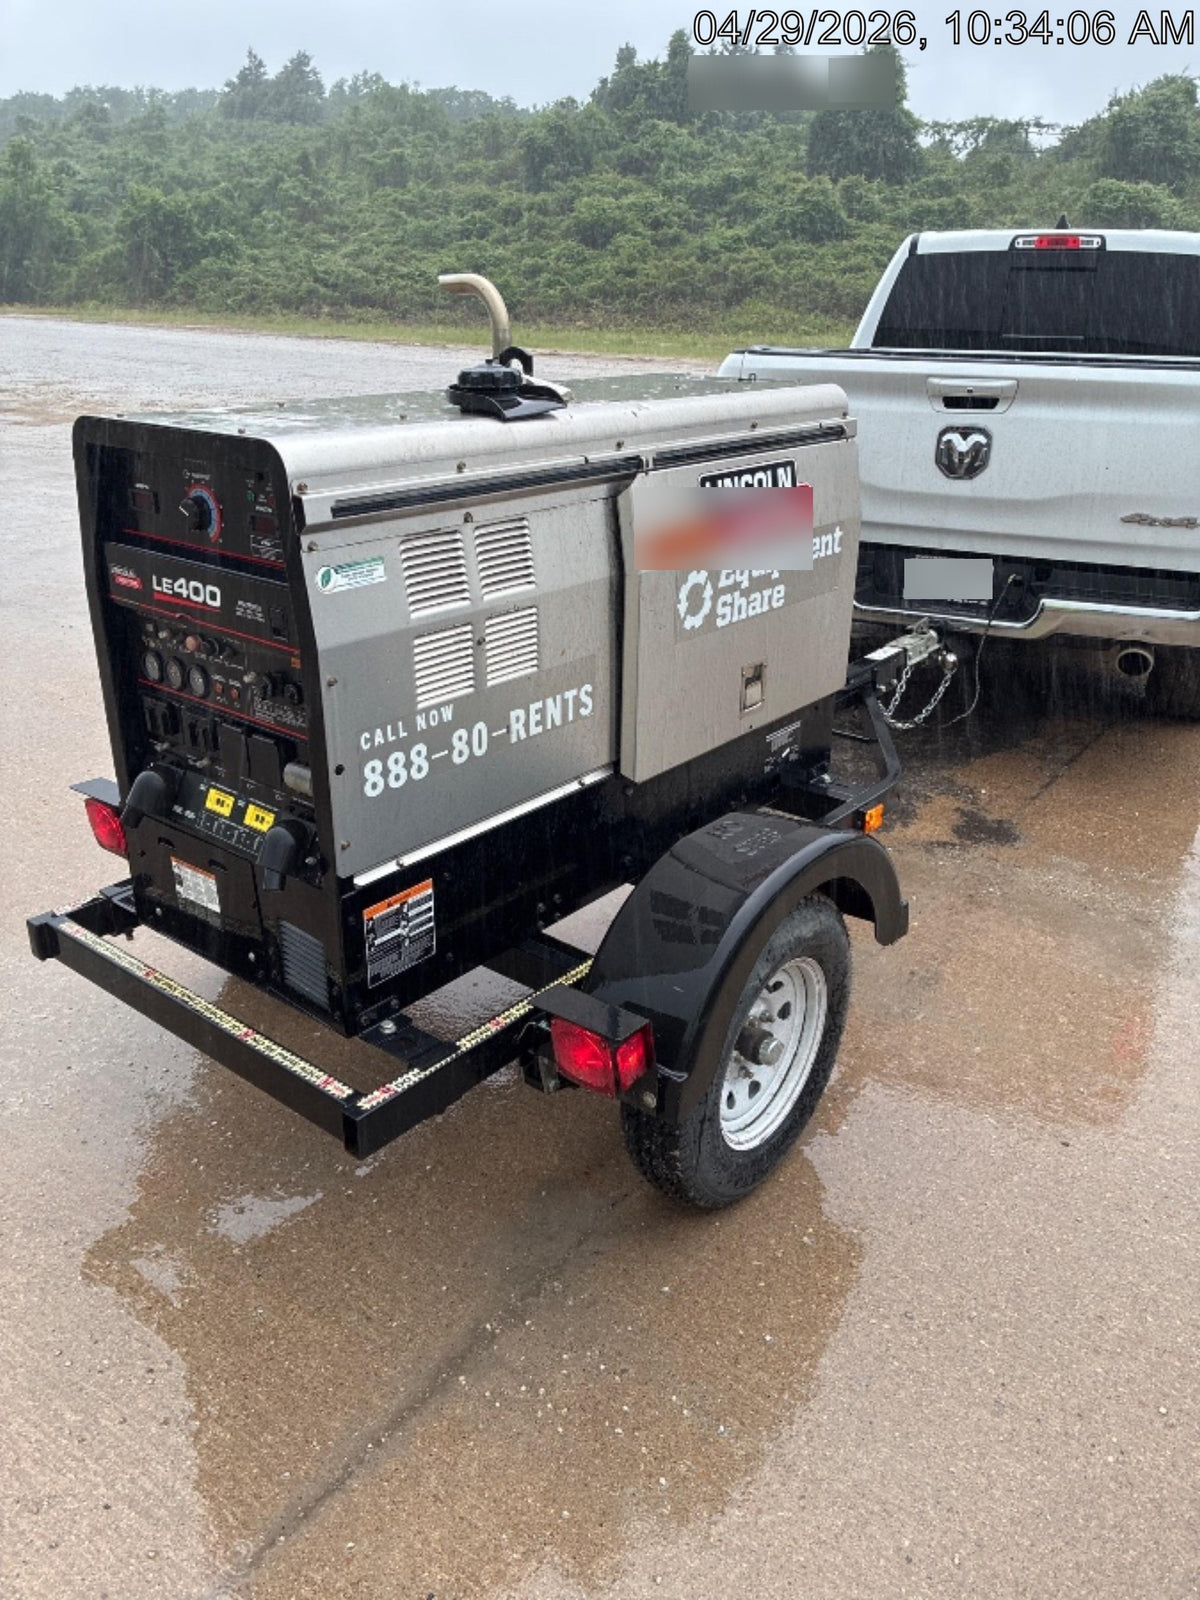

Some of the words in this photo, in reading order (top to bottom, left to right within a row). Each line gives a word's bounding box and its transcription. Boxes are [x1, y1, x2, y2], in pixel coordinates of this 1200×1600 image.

[151, 574, 222, 608] LE400
[715, 583, 785, 628] Share
[359, 721, 408, 751] CALL
[415, 703, 454, 733] NOW
[362, 683, 594, 798] 888-80-RENTS
